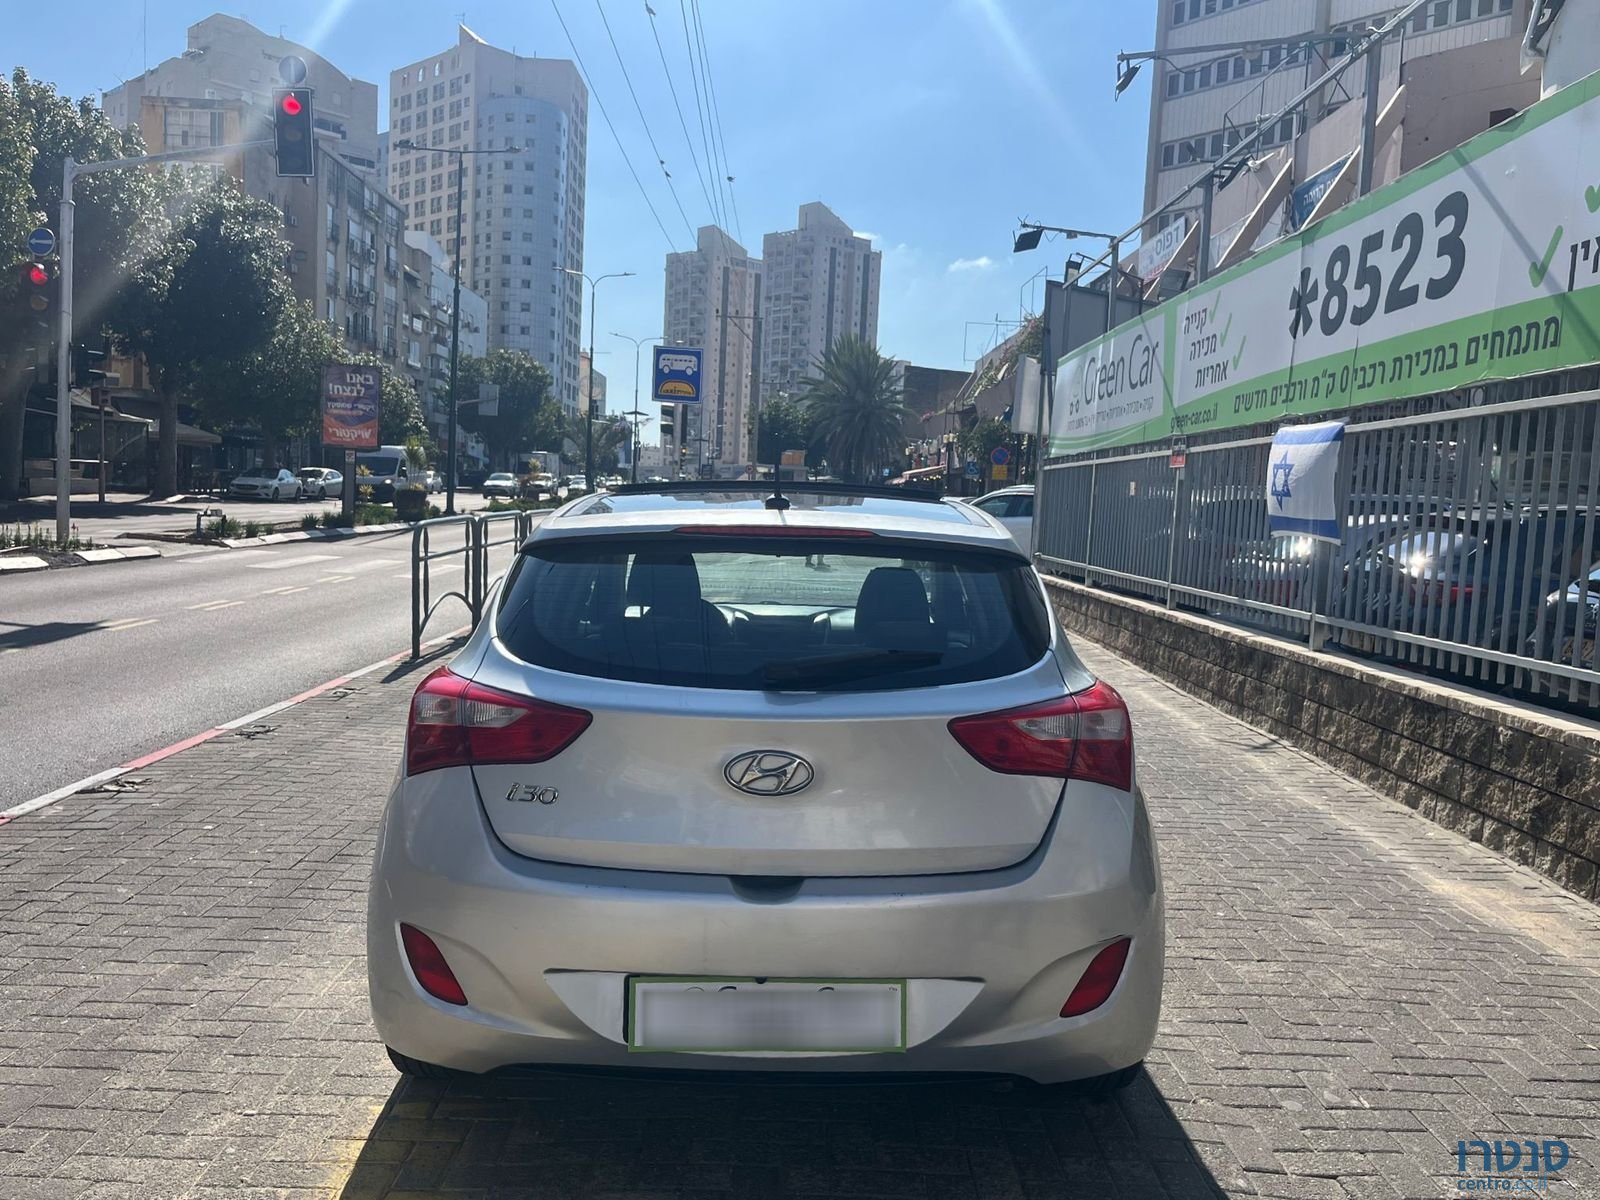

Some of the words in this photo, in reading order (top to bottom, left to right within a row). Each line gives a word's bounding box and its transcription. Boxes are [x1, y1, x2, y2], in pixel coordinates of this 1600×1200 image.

[1155, 226, 1180, 255] דפוס
[1184, 308, 1208, 335] קנייה
[1189, 333, 1217, 361] מכירה
[1465, 316, 1561, 366] מתמחים
[1084, 356, 1125, 405] Green
[1128, 334, 1159, 390] Car
[1195, 360, 1229, 388] אחריות
[1353, 360, 1386, 390] רכבי
[1389, 342, 1458, 383] במכירת
[329, 383, 365, 397] לנצח!
[346, 372, 374, 385] באנו
[1270, 379, 1308, 406] ורכבים
[1233, 388, 1268, 414] חדשים
[1170, 402, 1218, 433] green-car.co.il
[505, 782, 559, 805] i30
